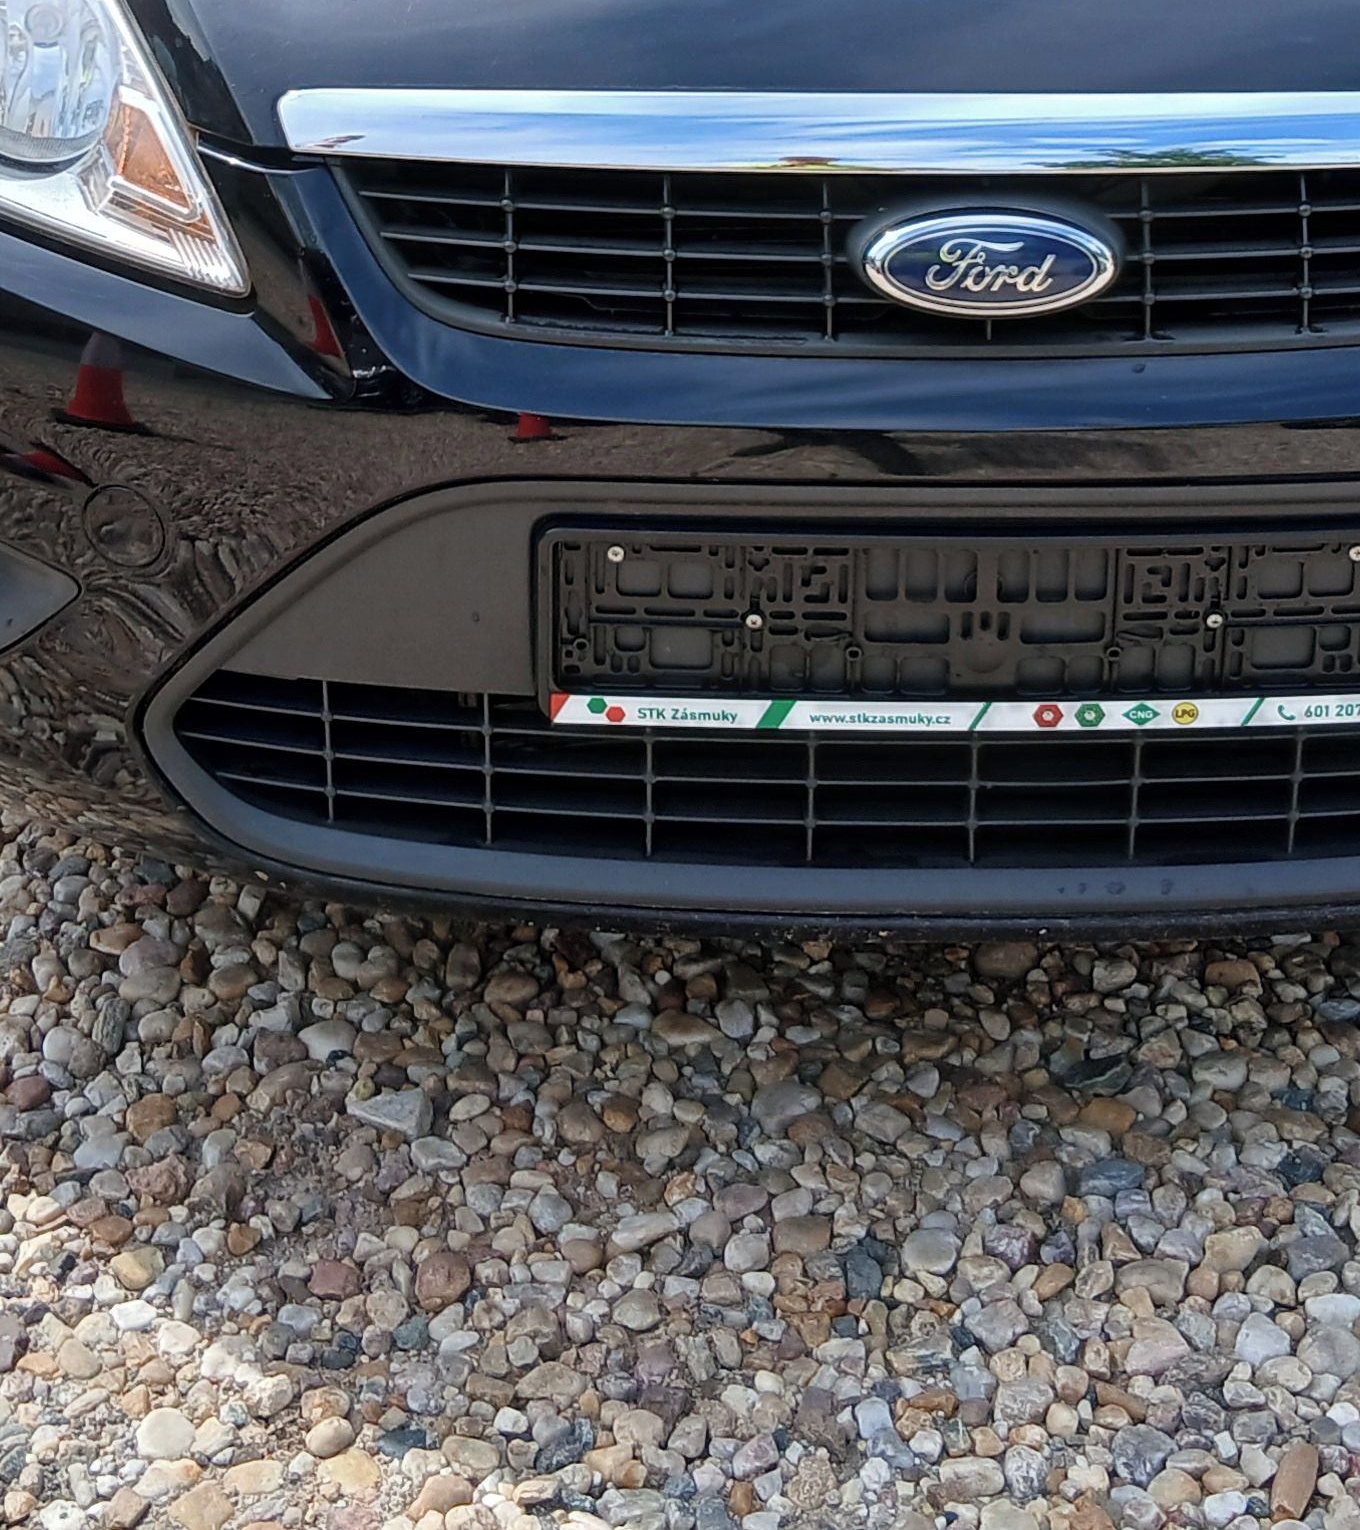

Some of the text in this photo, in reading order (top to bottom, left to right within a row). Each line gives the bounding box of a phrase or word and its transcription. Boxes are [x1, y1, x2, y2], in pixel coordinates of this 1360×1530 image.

[925, 237, 1057, 293] Ford
[637, 707, 738, 724] STK Zásmuky
[1128, 710, 1154, 719] CNG
[1175, 709, 1196, 718] LPG
[1304, 705, 1330, 718] 601
[809, 712, 952, 727] www.stkzasmuky.cz
